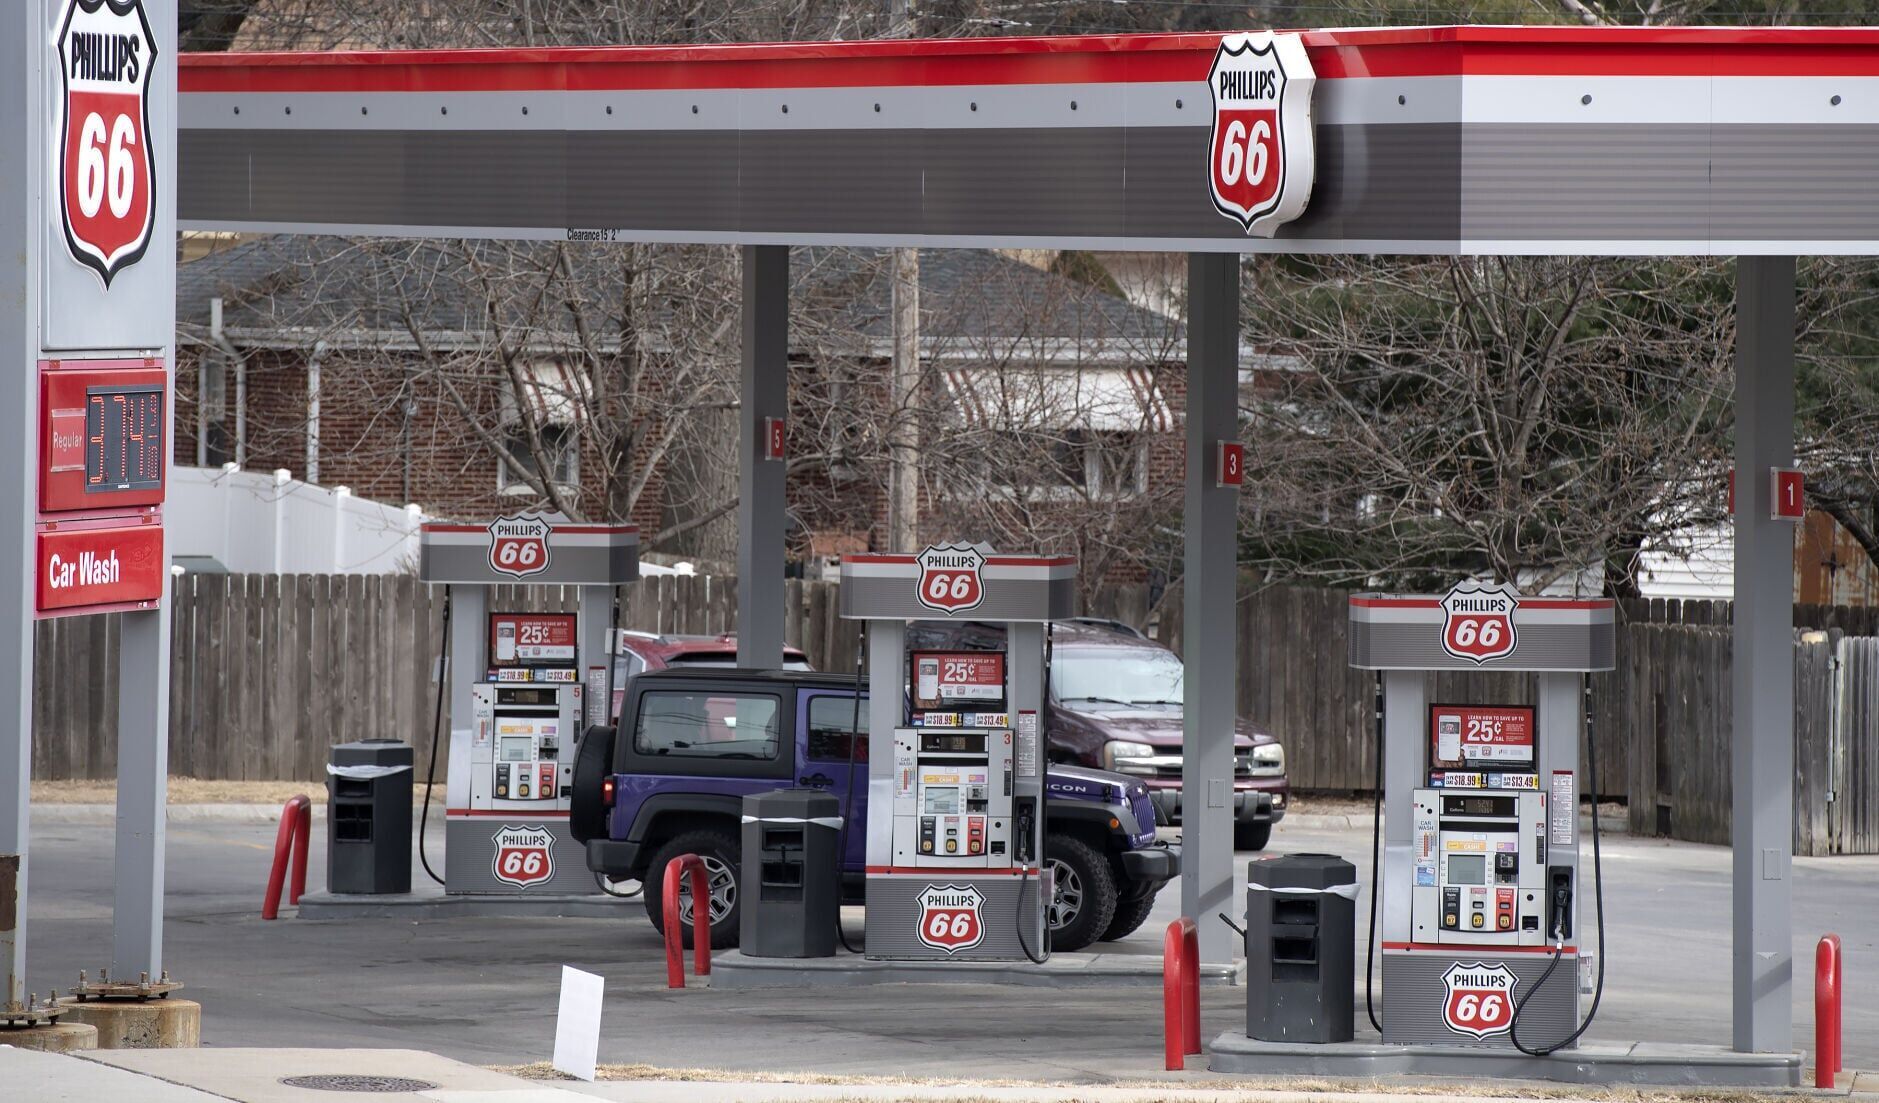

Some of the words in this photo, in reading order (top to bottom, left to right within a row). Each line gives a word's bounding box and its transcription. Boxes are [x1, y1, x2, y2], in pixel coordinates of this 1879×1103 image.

[71, 31, 140, 84] PHILLIPS
[1220, 69, 1275, 100] PHILLIPS
[1221, 120, 1271, 186] 66
[78, 111, 136, 219] 66
[567, 228, 600, 241] Clearance
[53, 432, 82, 452] Regular
[774, 429, 780, 449] 5
[1229, 453, 1237, 475] 3
[1787, 482, 1794, 507] 1
[498, 525, 542, 536] PHILLIPS
[500, 541, 539, 565] 66
[928, 556, 975, 568] PHILLIPS
[49, 553, 76, 589] Car
[79, 549, 120, 586] Wash
[929, 574, 972, 599] 66
[1453, 599, 1506, 612] PHILLIPS
[1455, 619, 1503, 647] 66
[574, 688, 580, 698] 5
[932, 714, 952, 725] $18.99
[984, 715, 1004, 726] $13.49
[1004, 734, 1011, 745] 3
[1046, 783, 1086, 792] ICON
[1454, 774, 1476, 786] $18.99
[1511, 776, 1534, 788] $13.49
[502, 835, 545, 846] PHILLIPS
[504, 851, 542, 874] 66
[928, 894, 974, 906] PHILLIPS
[929, 913, 971, 938] 66
[1454, 974, 1506, 988] PHILLIPS
[1456, 994, 1502, 1022] 66
